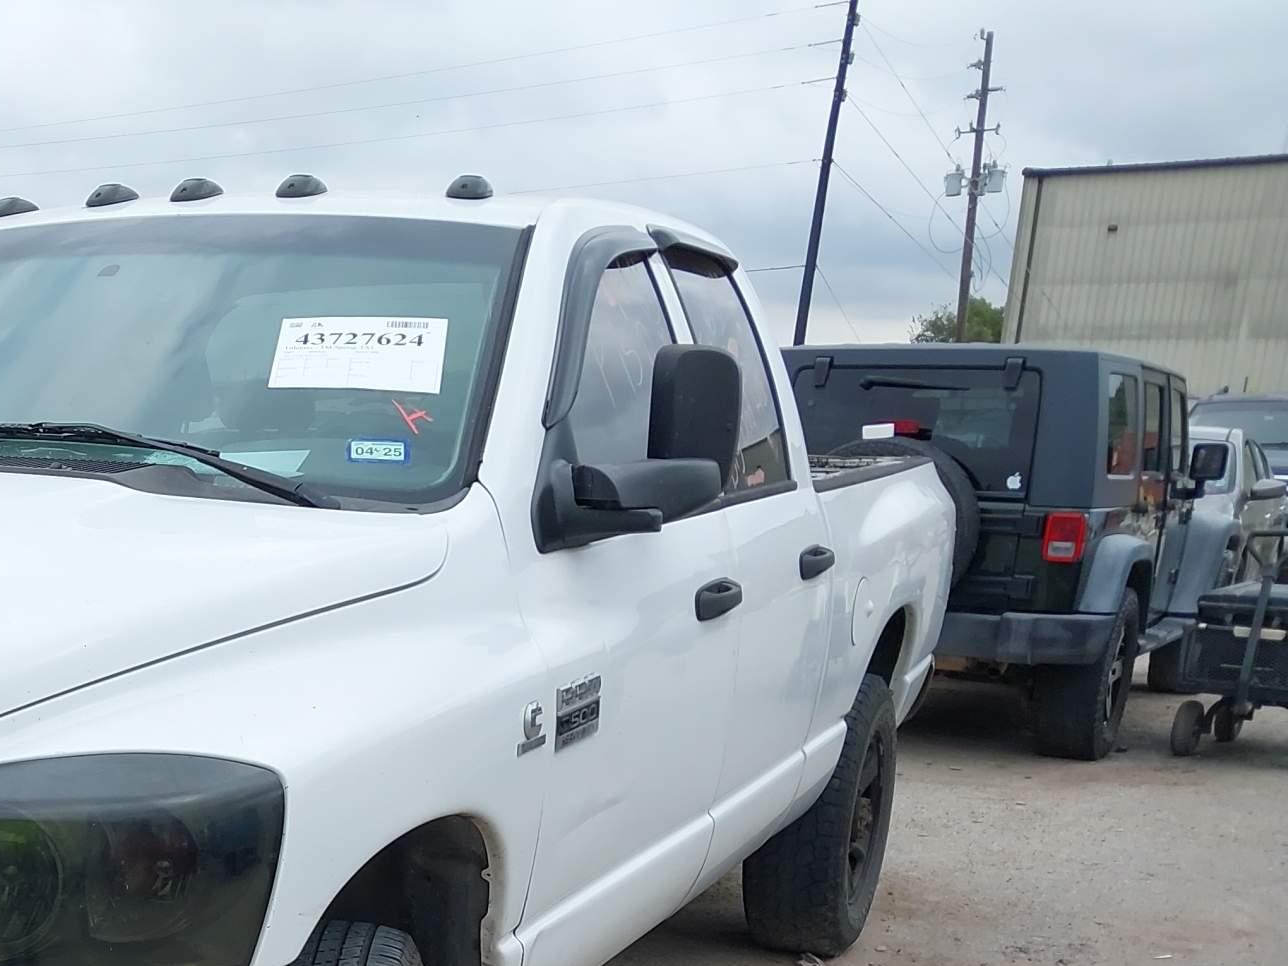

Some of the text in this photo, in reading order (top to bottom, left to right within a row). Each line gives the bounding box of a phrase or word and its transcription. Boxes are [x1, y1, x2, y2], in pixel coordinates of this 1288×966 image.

[295, 332, 425, 347] 43727624
[355, 446, 402, 457] 04 25
